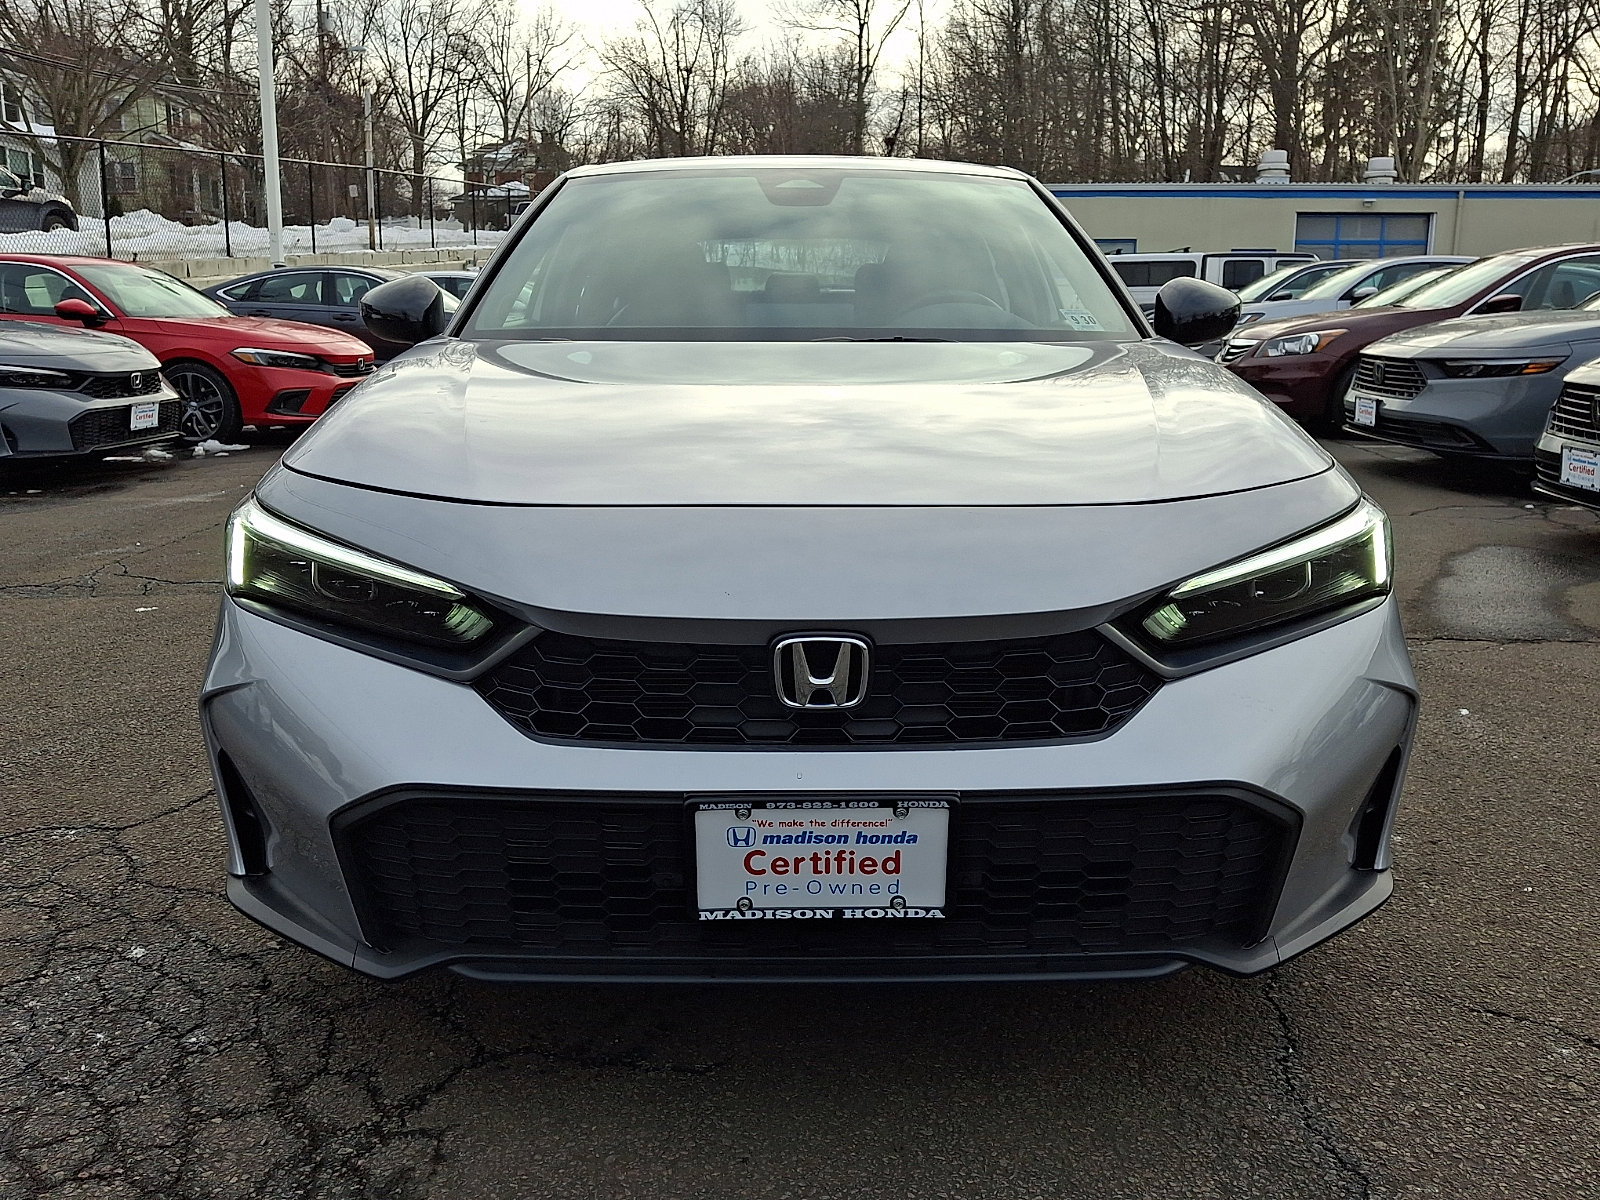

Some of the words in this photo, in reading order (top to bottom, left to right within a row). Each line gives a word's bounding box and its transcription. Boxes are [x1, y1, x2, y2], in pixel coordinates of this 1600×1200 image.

[1070, 315, 1080, 325] 9
[1080, 315, 1097, 325] 30
[1568, 462, 1596, 476] Certified
[766, 801, 879, 809] 973-822-1600
[778, 819, 805, 828] make
[809, 819, 826, 828] the
[762, 830, 849, 845] madison
[855, 830, 919, 845] honda
[743, 849, 901, 875] Certified
[745, 879, 900, 895] Pre-Owned
[698, 909, 835, 921] MADISON
[842, 908, 946, 919] HONDA
